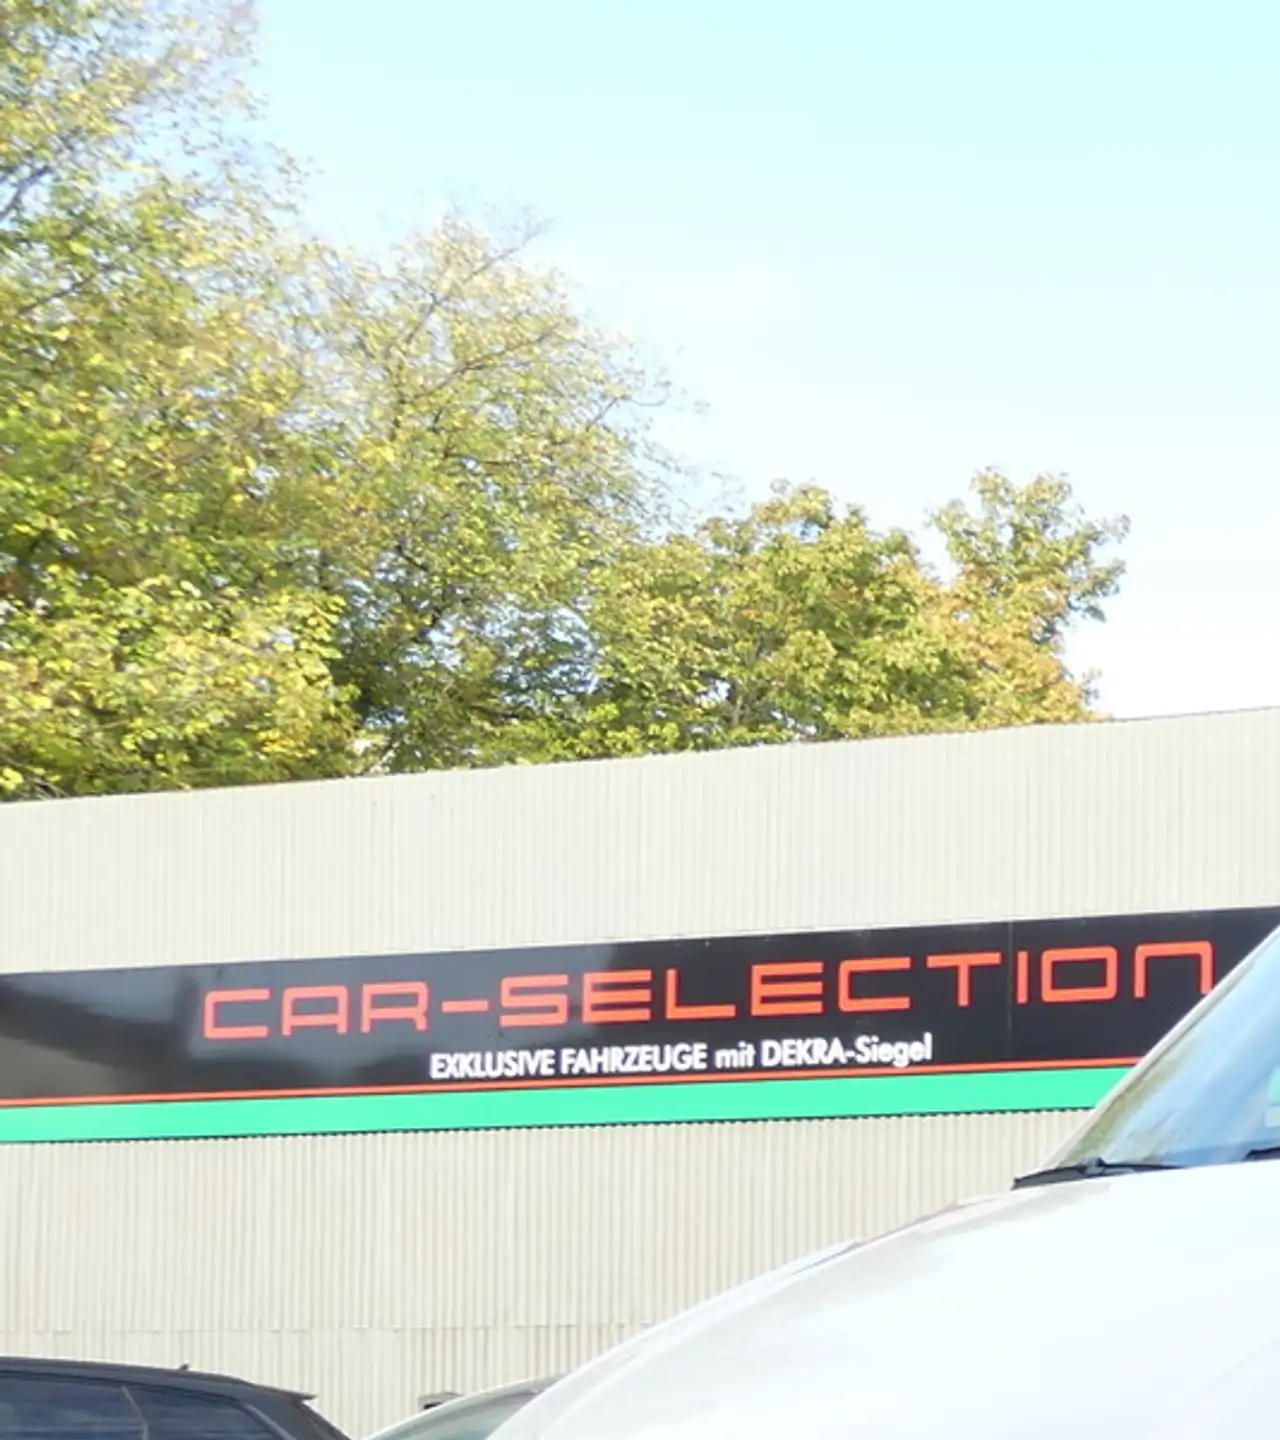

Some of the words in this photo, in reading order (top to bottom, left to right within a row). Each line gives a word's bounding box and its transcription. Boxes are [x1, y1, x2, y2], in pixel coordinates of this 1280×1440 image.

[203, 939, 1214, 1040] CAR-SELECTION
[429, 1048, 555, 1079] EXKLUSIVE
[559, 1042, 708, 1074] FAHRZEUGE
[715, 1041, 756, 1069] mit
[760, 1032, 933, 1068] DEKRA-Siegel
